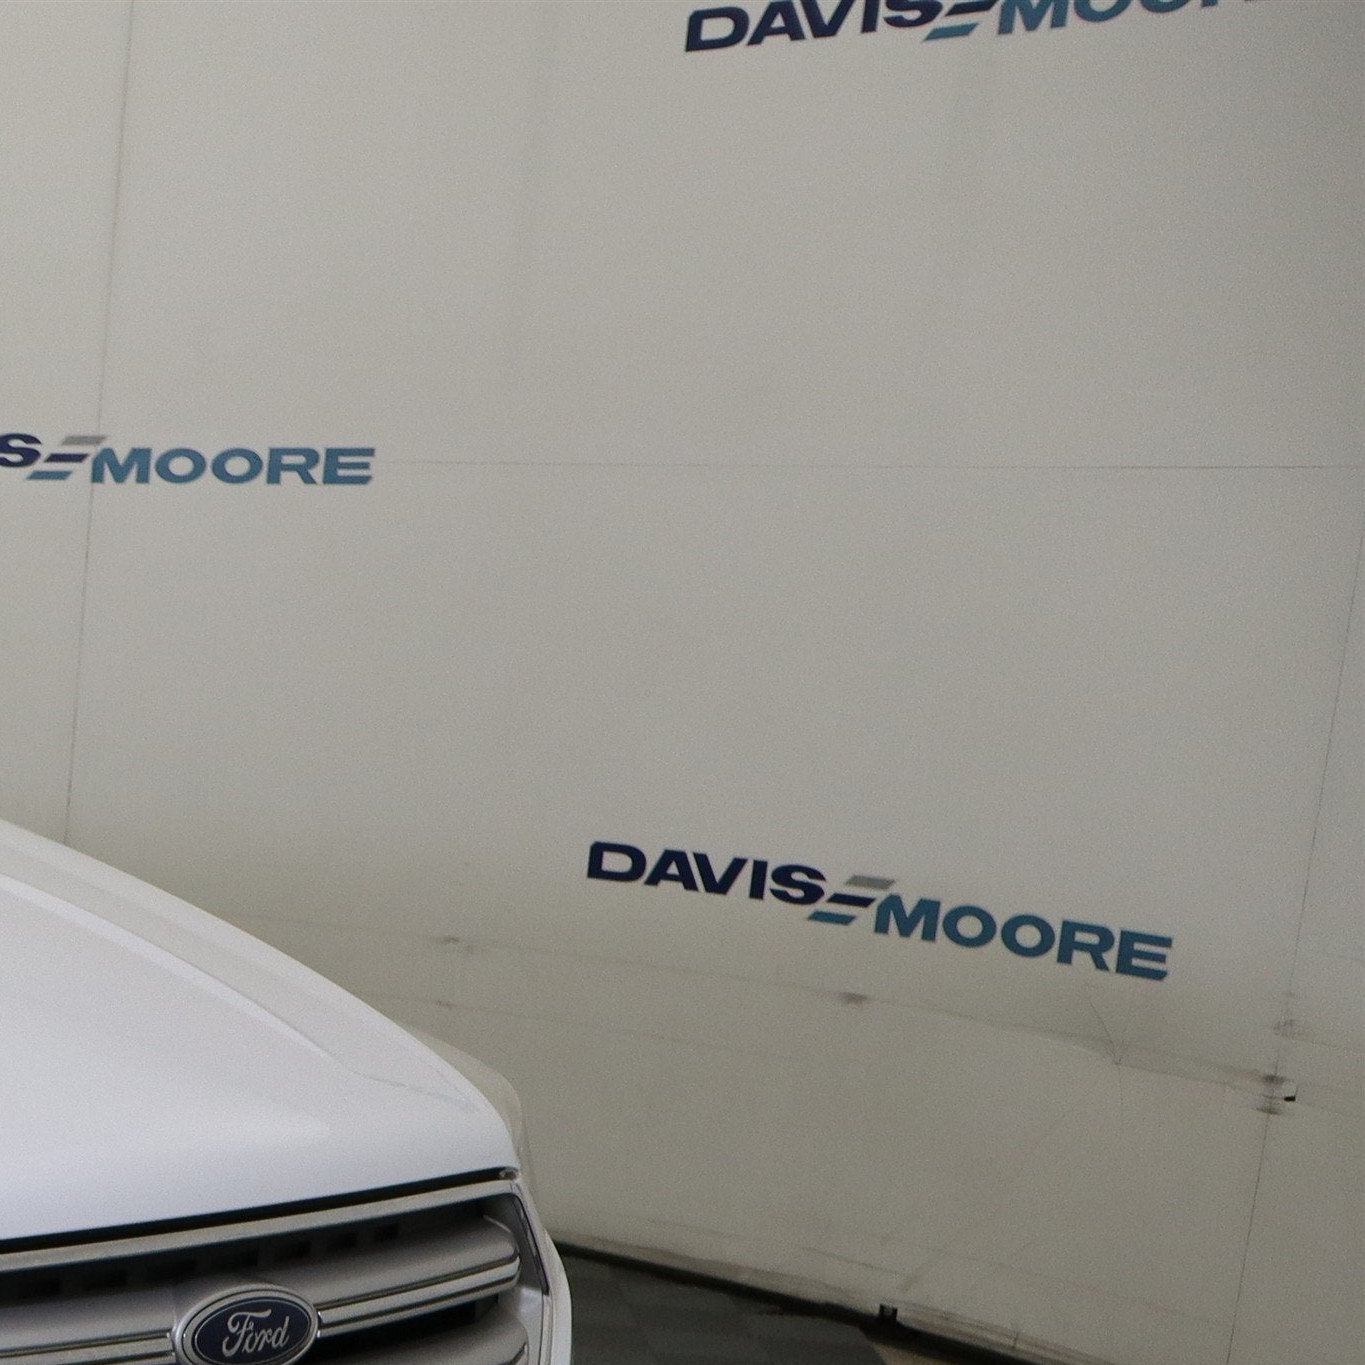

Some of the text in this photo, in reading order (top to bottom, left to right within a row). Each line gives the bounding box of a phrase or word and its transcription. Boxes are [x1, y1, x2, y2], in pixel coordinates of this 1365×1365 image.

[685, 0, 937, 52] DAVIS
[90, 446, 376, 485] MOORE
[586, 840, 1174, 982] DAVIS MOORE
[222, 1308, 290, 1358] Ford
